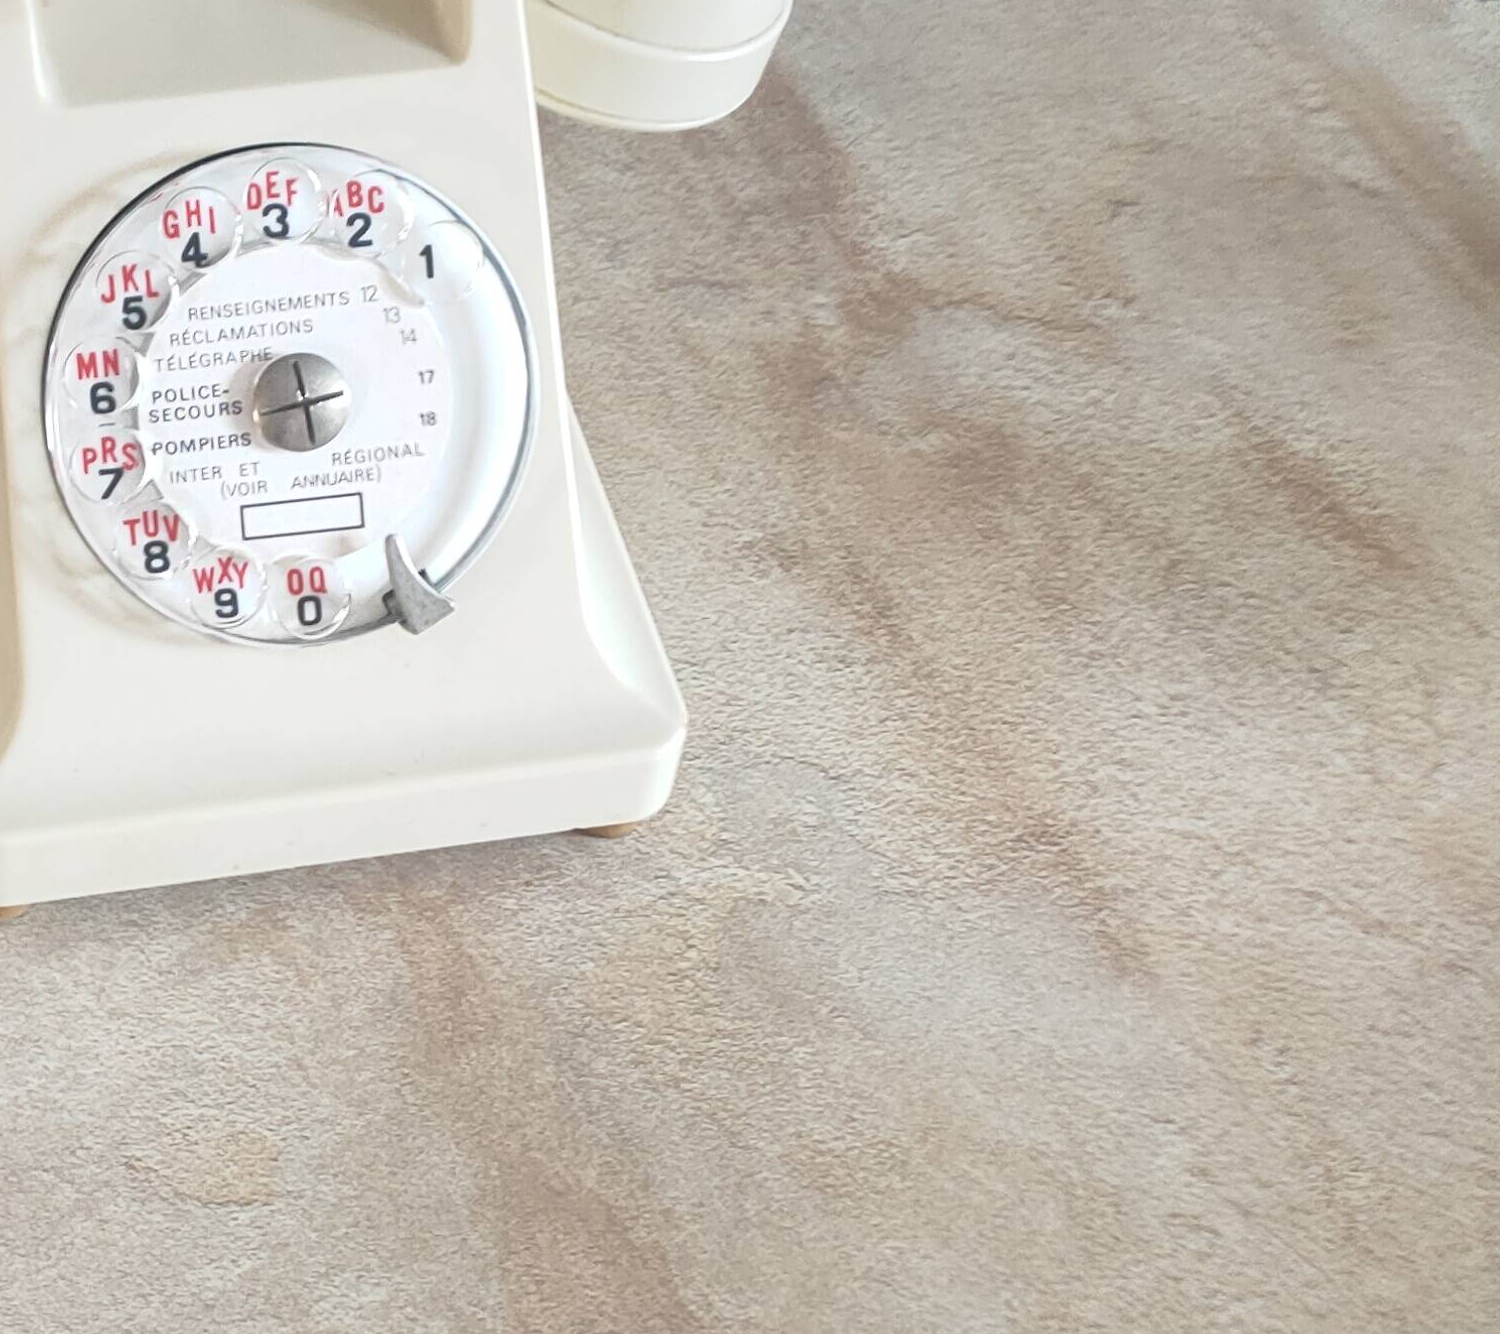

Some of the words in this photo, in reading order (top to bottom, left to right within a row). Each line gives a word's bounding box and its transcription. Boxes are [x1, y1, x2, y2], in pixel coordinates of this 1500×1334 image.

[246, 171, 298, 210] DEF
[331, 180, 385, 218] ABC
[163, 199, 216, 239] GHI
[262, 203, 290, 238] 3
[346, 212, 373, 248] 2
[181, 232, 208, 268] 4
[419, 244, 434, 278] 1
[101, 263, 160, 304] JKL
[122, 296, 147, 330] 5
[187, 291, 350, 322] RENSEIGNEMENTS
[361, 285, 380, 303] 12
[169, 319, 314, 346] RÉCLAMATIONS
[383, 306, 402, 324] 13
[76, 348, 120, 380] MN
[156, 347, 273, 373] TÉLÉGRAPHE
[90, 381, 116, 414] 6
[149, 401, 244, 423] SECOURS
[418, 370, 435, 385] 17
[152, 384, 230, 404] POLICE-
[151, 432, 252, 456] POMPIERS
[420, 412, 437, 426] 18
[81, 436, 140, 474] PRS
[169, 467, 222, 484] INTER
[239, 462, 261, 477] ET
[331, 443, 425, 466] RÉGIONAL
[98, 468, 125, 500] 7
[220, 481, 268, 500] (VOIR
[290, 467, 382, 490] ANNUAIRE)
[123, 510, 180, 546] TUV
[144, 540, 170, 574] 8
[192, 556, 248, 593] WXY
[214, 588, 239, 618] 9
[297, 595, 322, 626] 0
